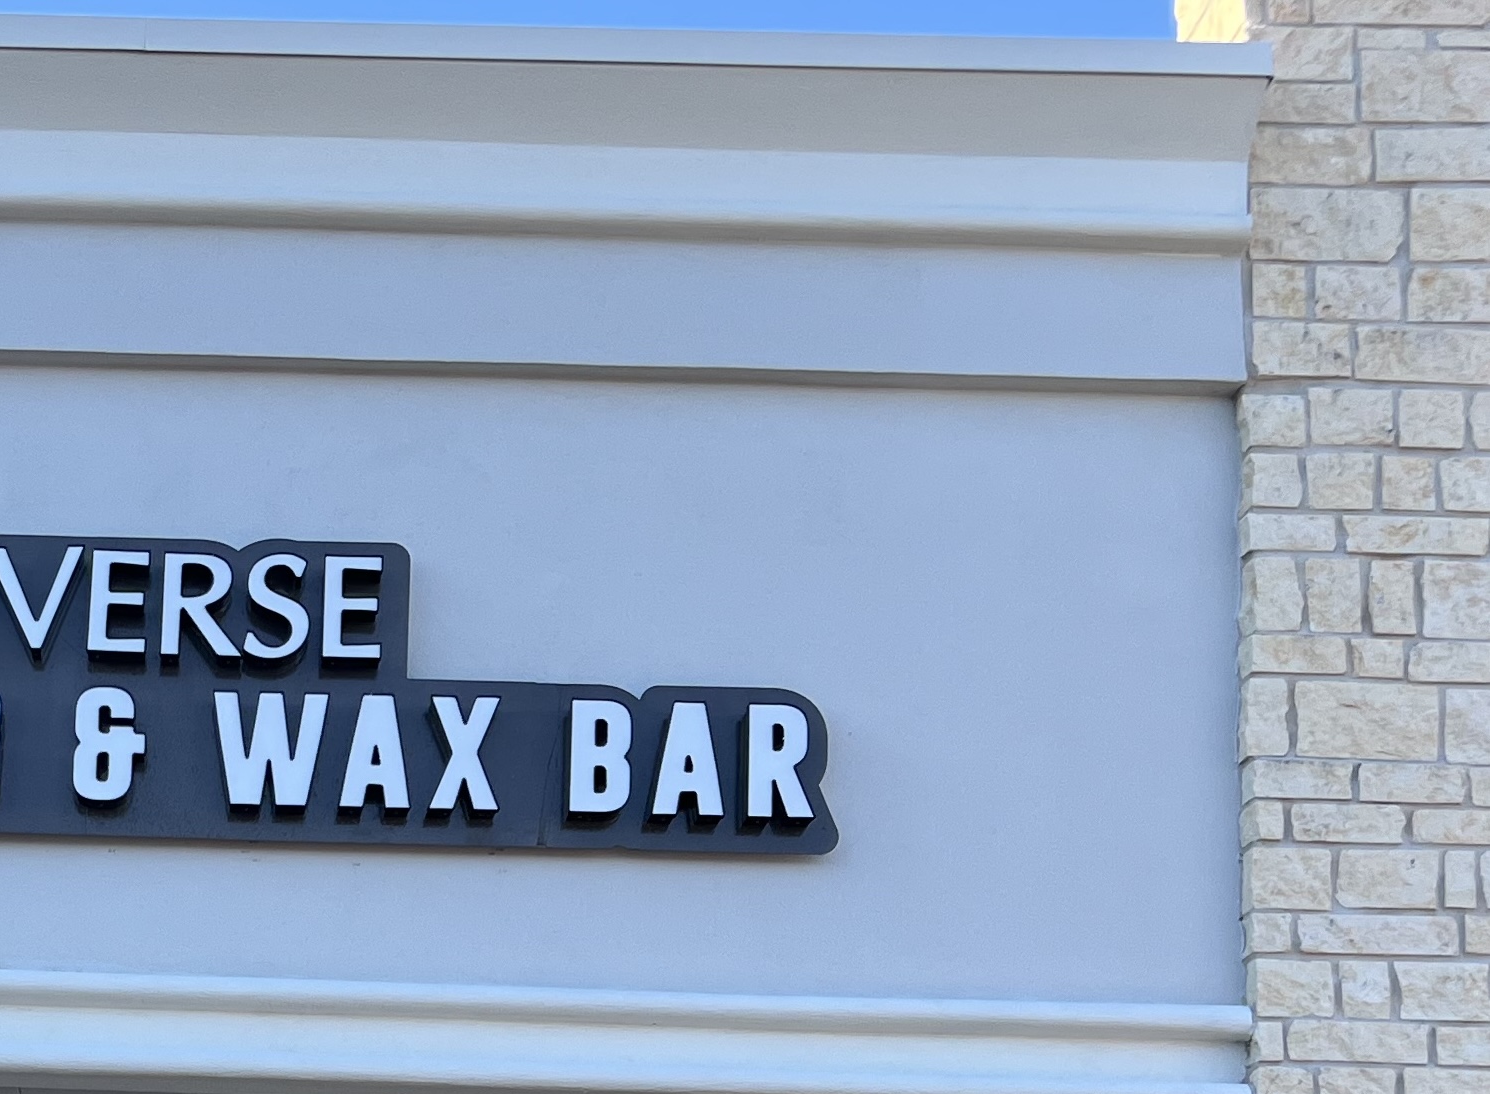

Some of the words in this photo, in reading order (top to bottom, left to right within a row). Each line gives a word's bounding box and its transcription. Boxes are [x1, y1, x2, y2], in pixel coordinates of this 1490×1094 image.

[72, 685, 146, 801] &
[212, 689, 501, 814] WAX
[569, 697, 815, 819] BAR
